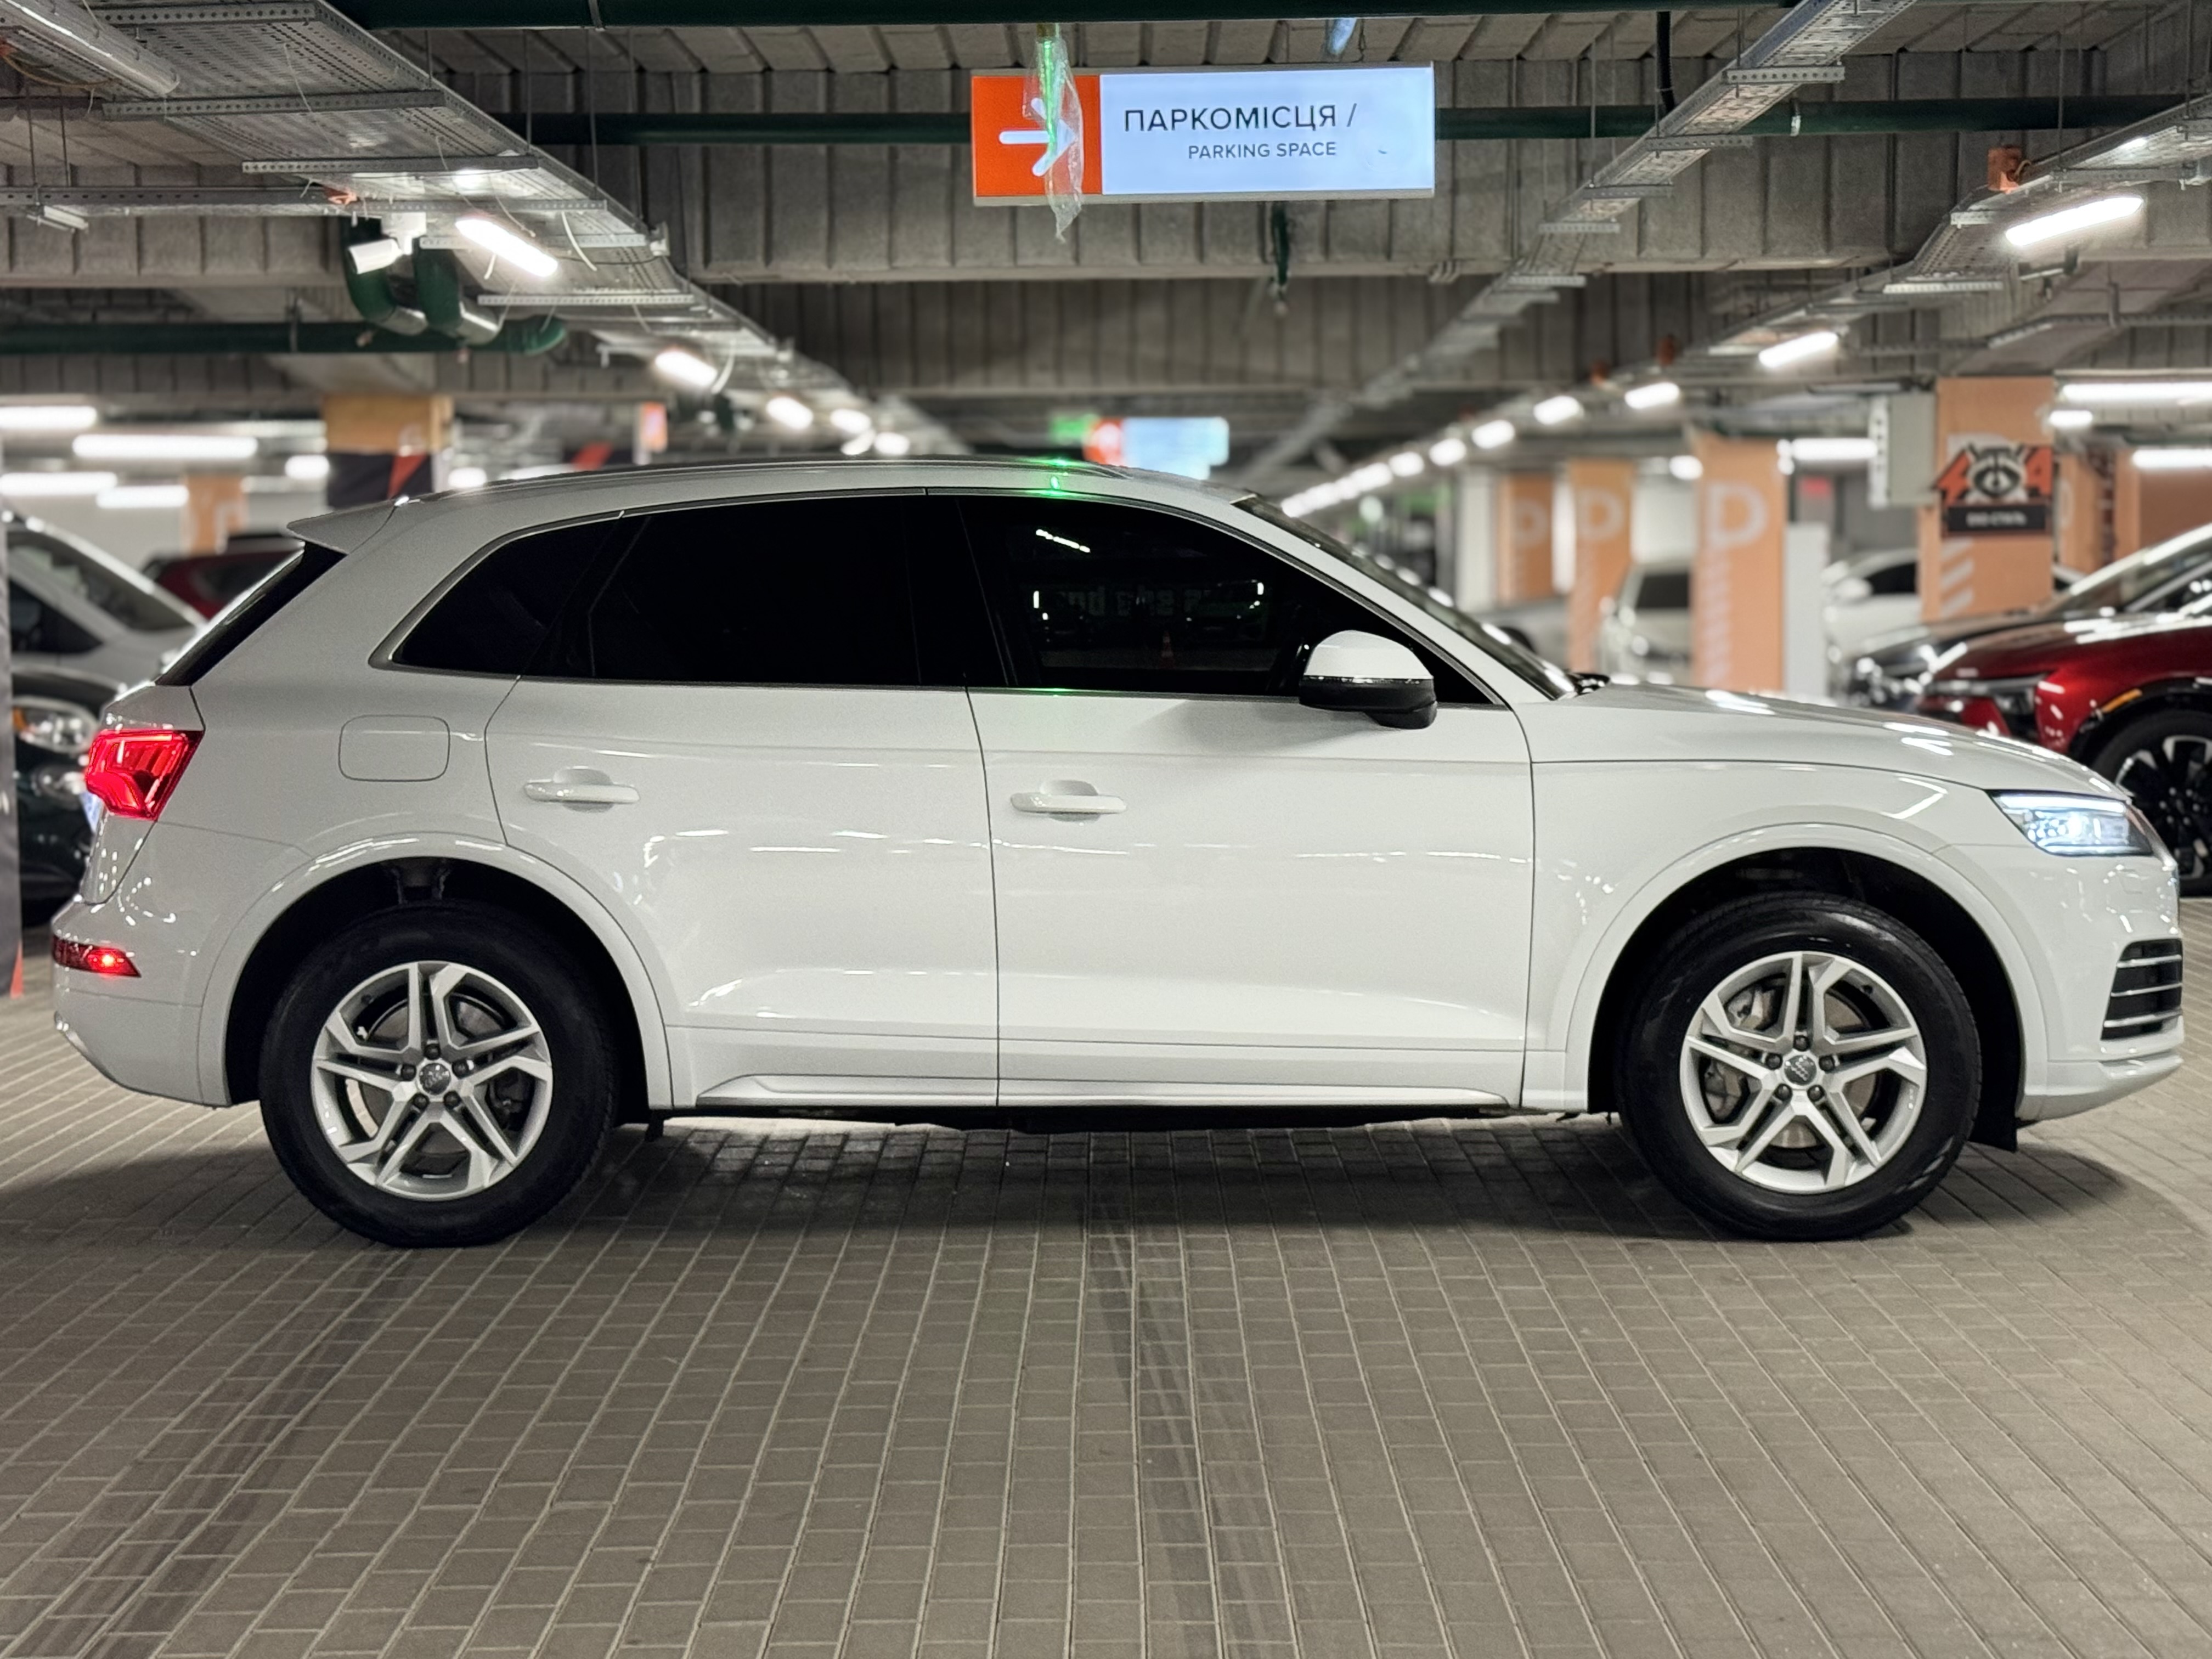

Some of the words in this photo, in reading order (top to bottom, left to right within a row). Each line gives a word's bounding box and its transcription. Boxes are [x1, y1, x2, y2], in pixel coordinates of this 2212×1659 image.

[1124, 104, 1336, 131] ПАРКОМІСЦЯ
[1188, 143, 1271, 159] PARKING
[1276, 141, 1337, 157] SPACE
